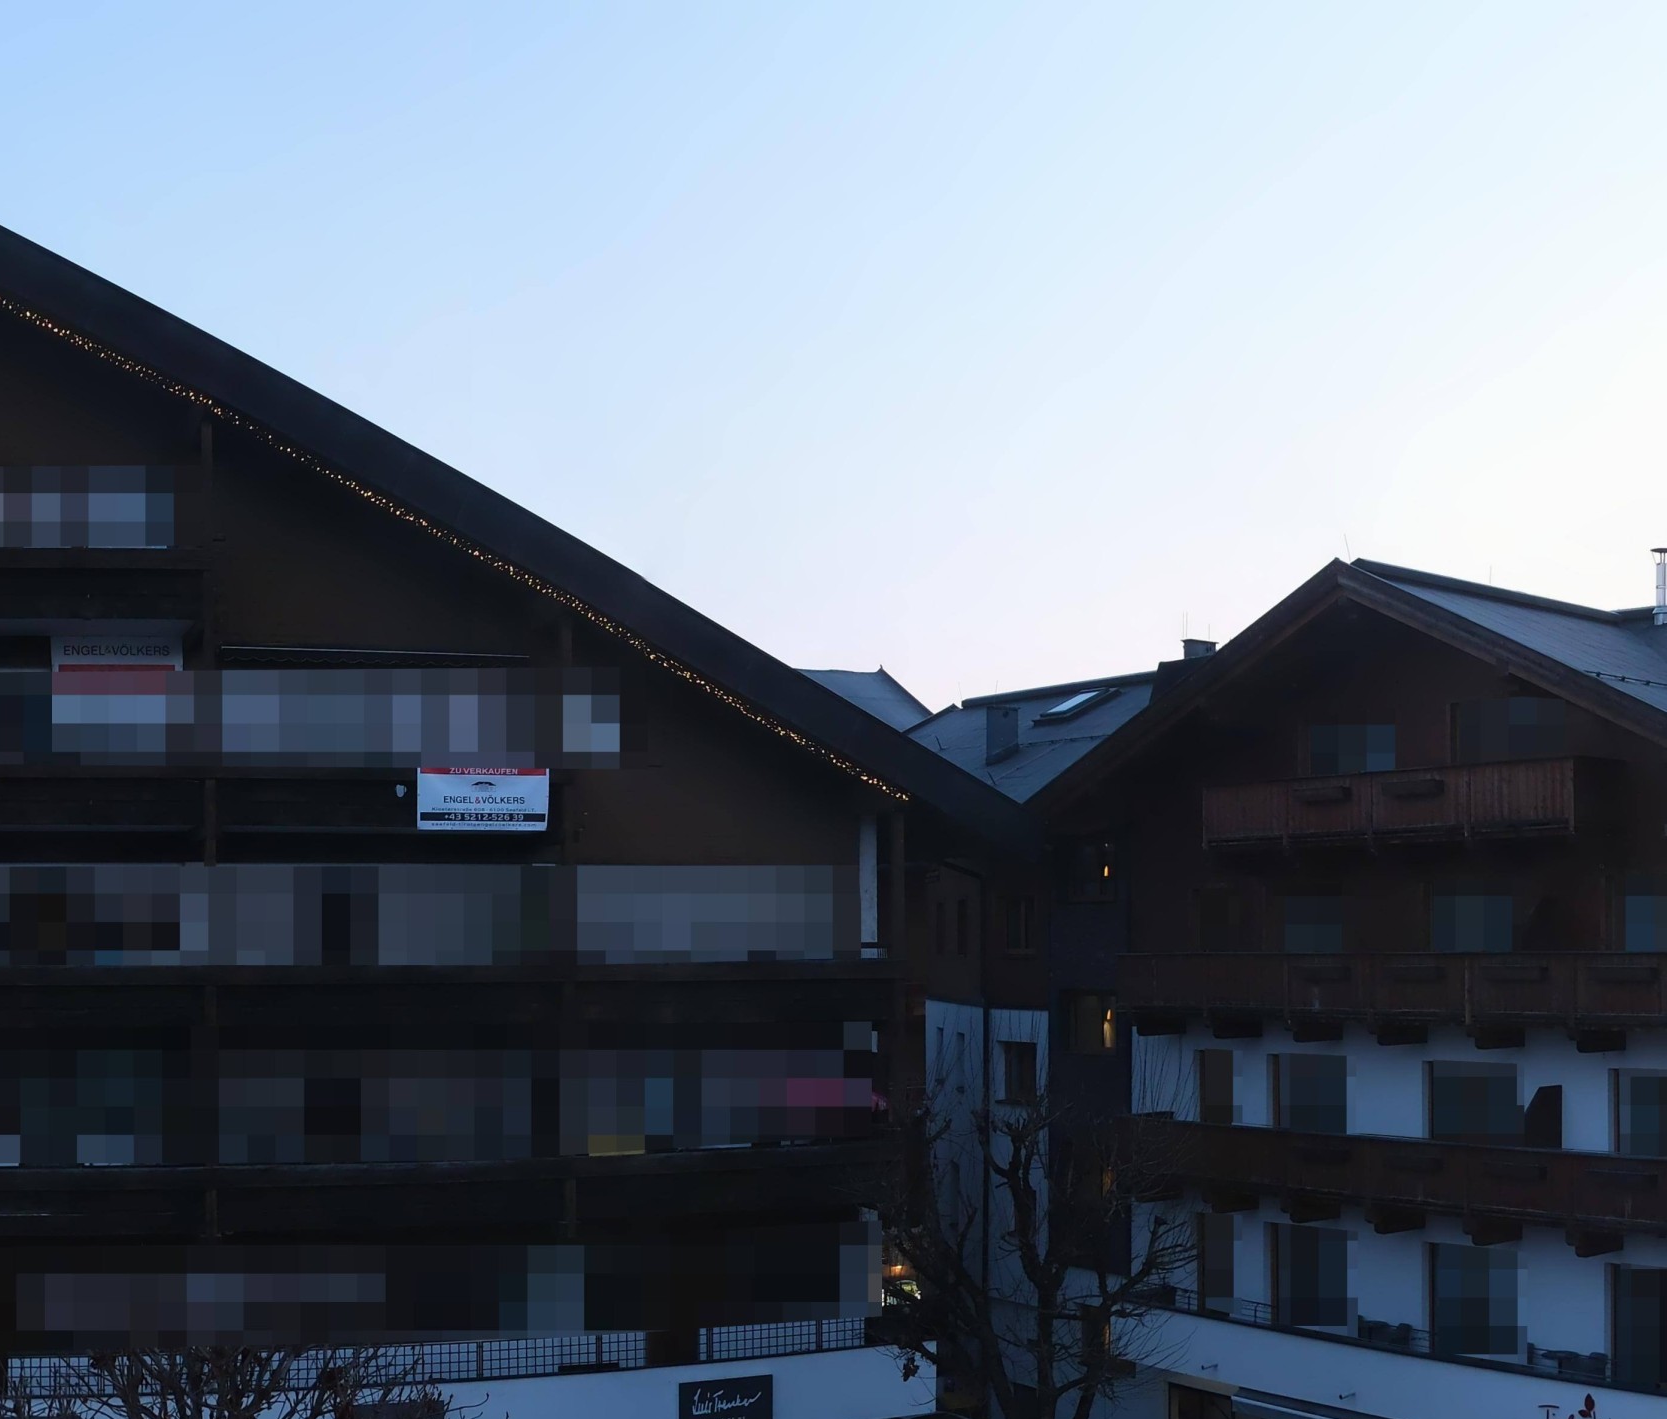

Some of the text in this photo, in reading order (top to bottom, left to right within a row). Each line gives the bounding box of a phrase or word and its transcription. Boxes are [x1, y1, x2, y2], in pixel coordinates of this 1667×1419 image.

[449, 767, 518, 775] ZU VERKAUFEN
[464, 813, 510, 821] 5212-526
